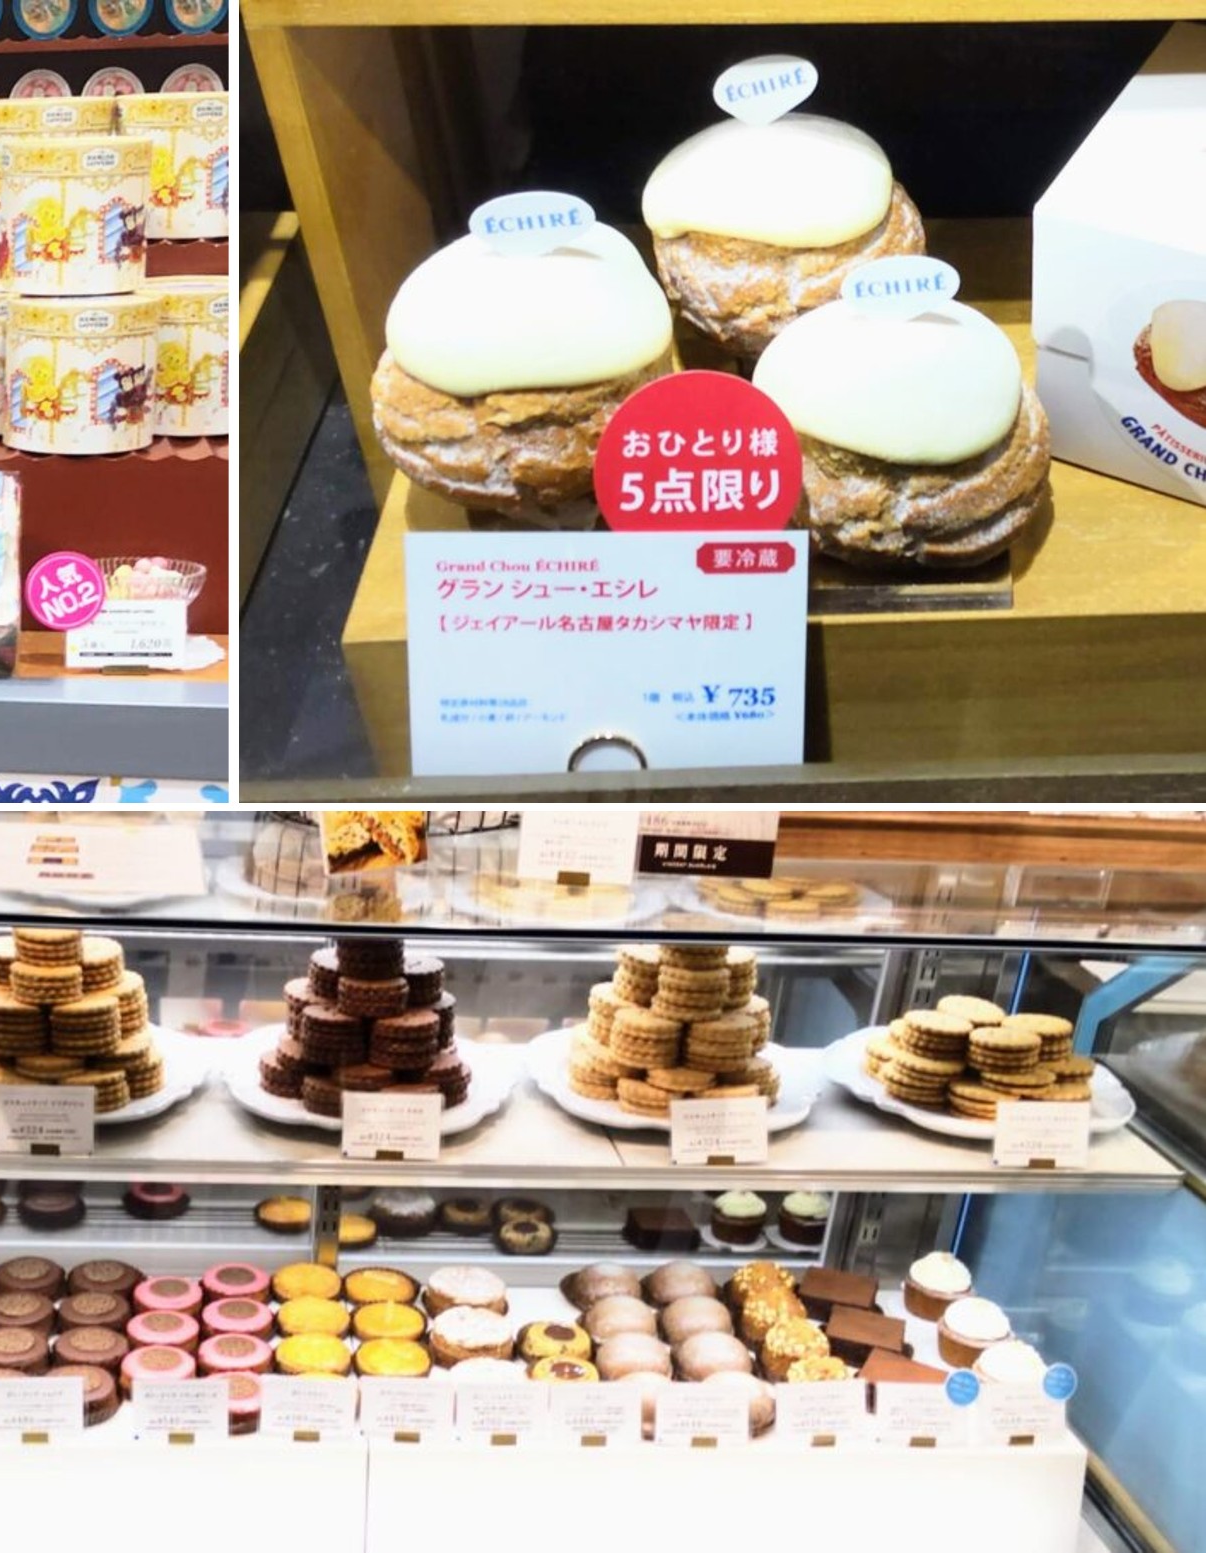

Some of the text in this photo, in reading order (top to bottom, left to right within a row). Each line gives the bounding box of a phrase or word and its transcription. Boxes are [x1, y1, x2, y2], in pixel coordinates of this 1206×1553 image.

[725, 66, 808, 103] ÉCHIRÉ
[484, 208, 583, 235] ÉCHIRÉ
[854, 272, 948, 300] ÉCHIRÉ
[622, 427, 779, 458] おひとり様
[1121, 416, 1179, 466] GRAND
[619, 467, 780, 514] 5点限り
[436, 557, 600, 572] Grand Chou ÉCHIRÉ
[713, 548, 779, 568] 要冷蔵
[40, 562, 83, 599] 人気
[41, 581, 100, 623] NO.2
[654, 841, 728, 862] 期間限定
